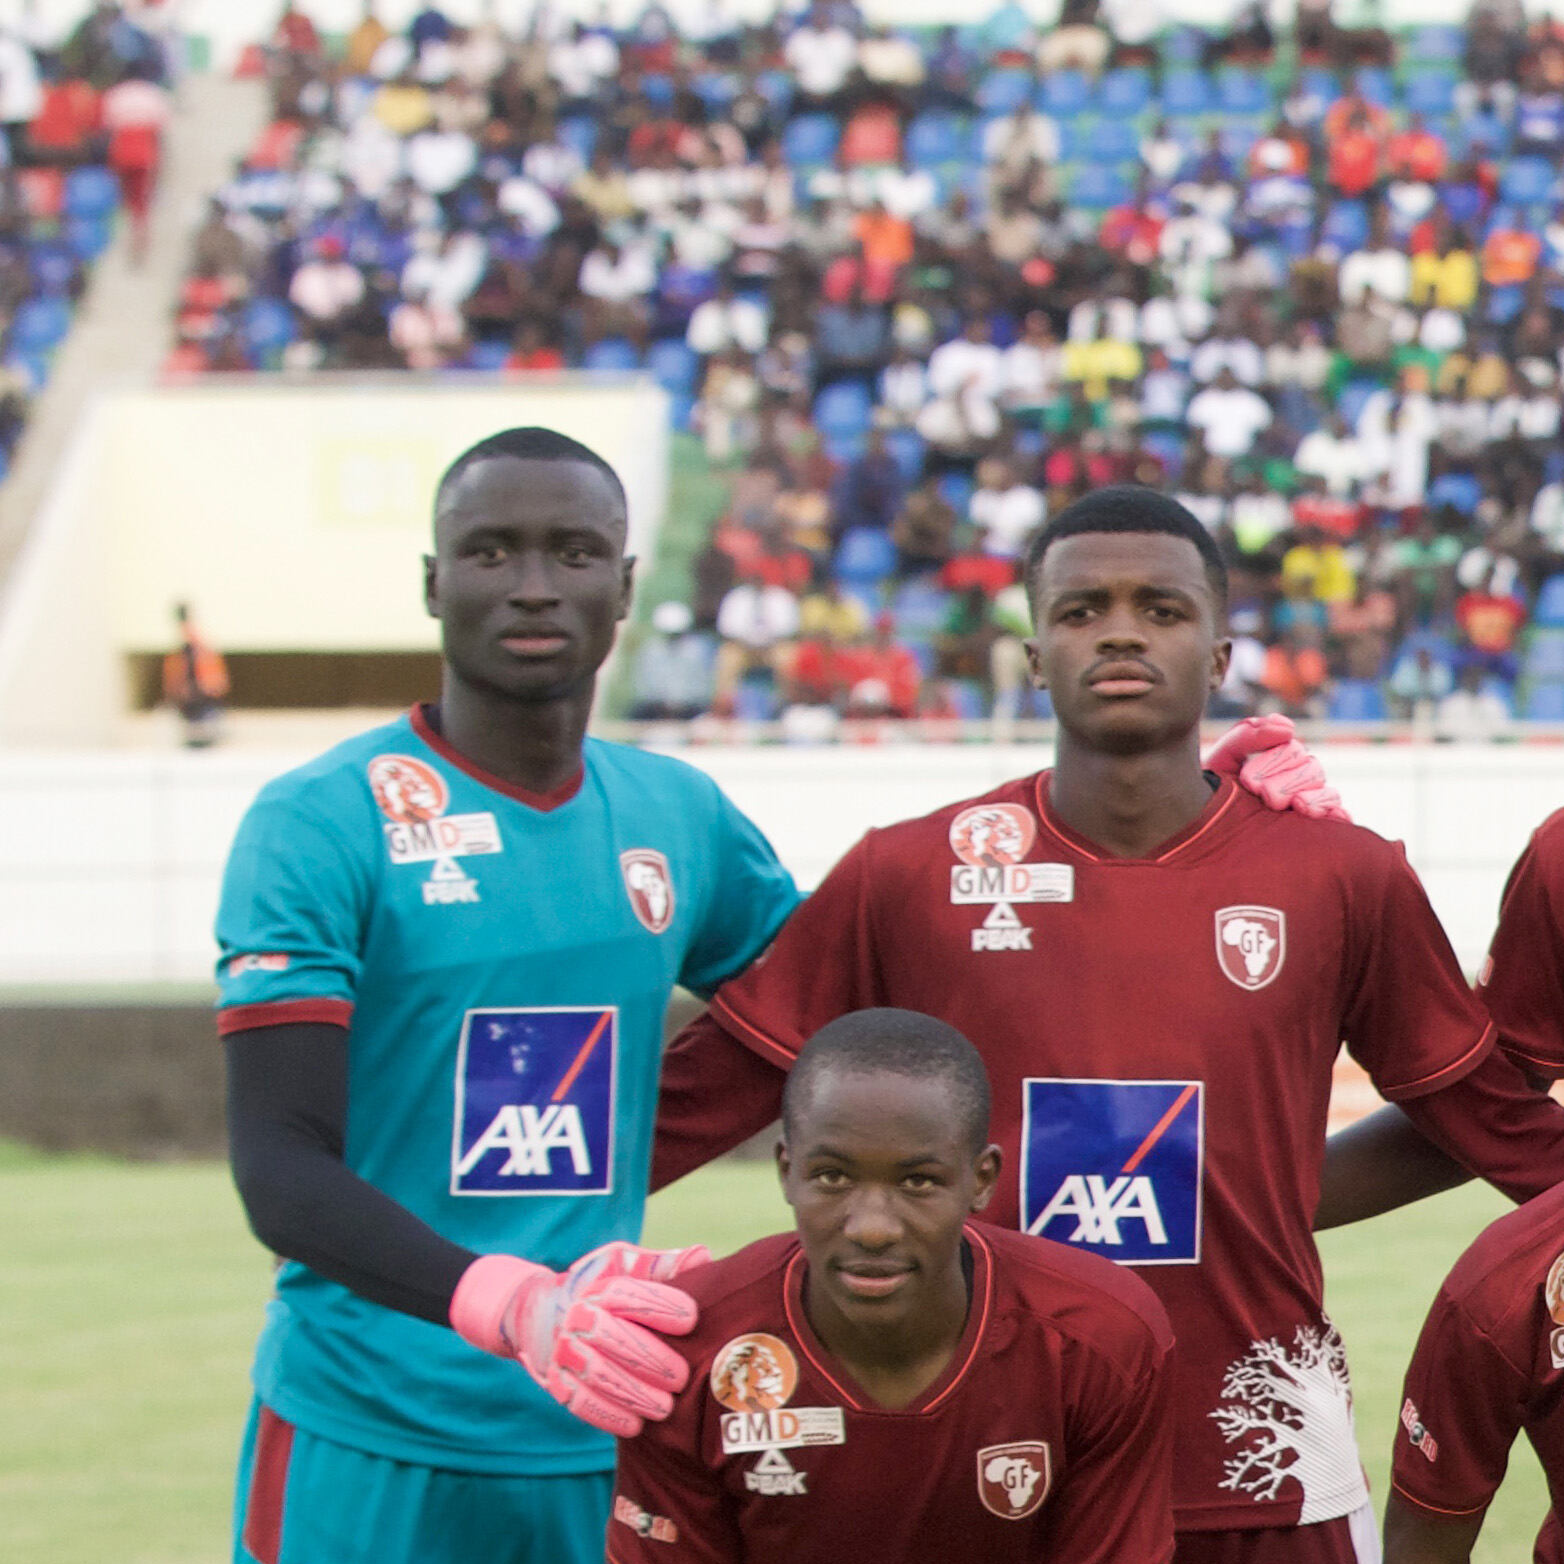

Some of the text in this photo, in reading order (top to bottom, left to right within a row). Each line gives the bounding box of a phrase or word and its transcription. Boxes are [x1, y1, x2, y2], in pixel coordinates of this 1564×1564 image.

[390, 820, 457, 855] GMD
[952, 867, 1031, 895] GMD
[971, 928, 1033, 951] PEAK
[1240, 929, 1264, 954] GF
[458, 1104, 590, 1176] AXA
[1027, 1175, 1168, 1245] AXA
[722, 1410, 799, 1445] GMD
[744, 1471, 808, 1496] PEAK
[1003, 1464, 1029, 1489] GF
